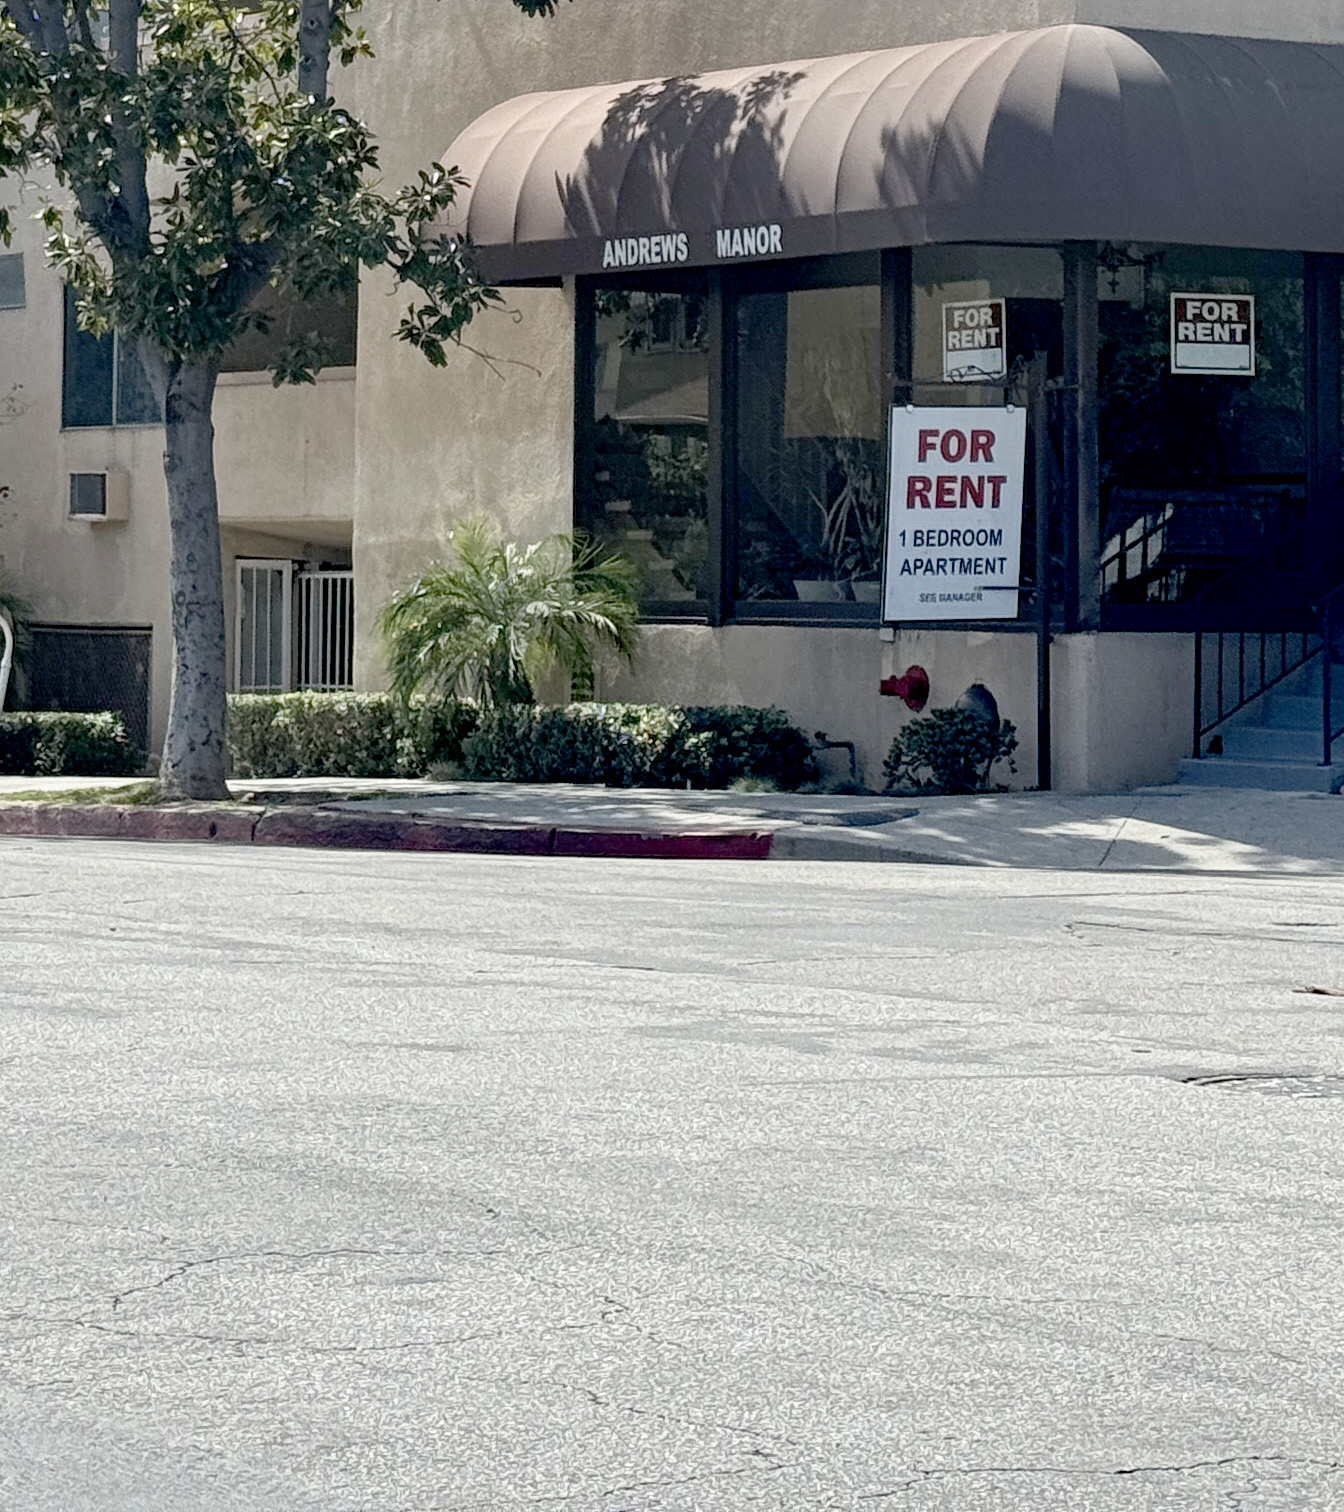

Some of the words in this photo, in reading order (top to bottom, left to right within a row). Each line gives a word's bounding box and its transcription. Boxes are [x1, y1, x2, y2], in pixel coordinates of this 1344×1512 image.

[603, 232, 689, 269] ANDREWS
[716, 224, 783, 259] MANOR
[954, 307, 993, 329] FOR
[1186, 301, 1239, 322] FOR
[948, 327, 1000, 349] RENT
[1178, 322, 1248, 343] RENT
[917, 429, 996, 463] FOR
[906, 475, 1007, 509] RENT
[899, 529, 906, 547] 1
[913, 528, 1003, 547] BEDROOM
[899, 557, 1007, 577] APARTMENT
